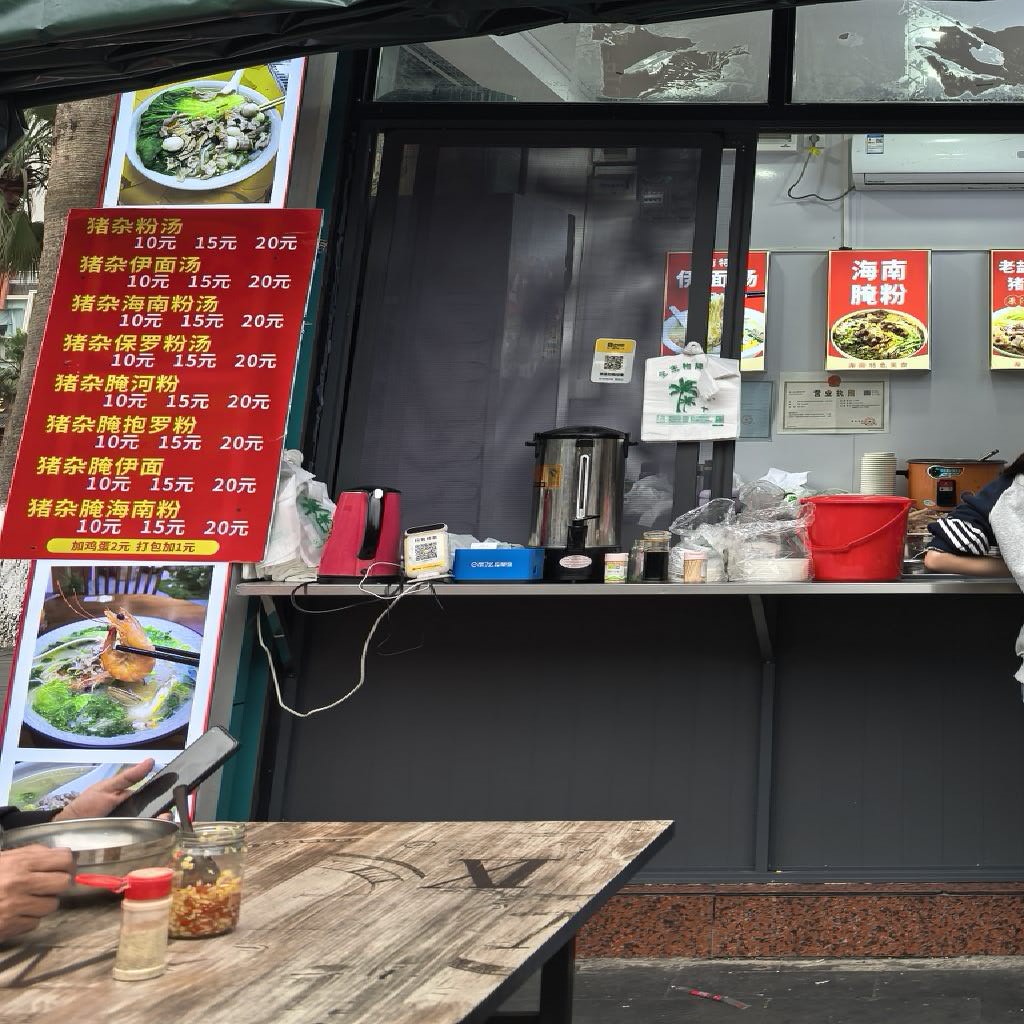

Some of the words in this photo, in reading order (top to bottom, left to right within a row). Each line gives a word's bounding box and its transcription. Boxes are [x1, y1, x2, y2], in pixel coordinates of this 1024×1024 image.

[87, 217, 183, 234] 猪杂粉汤
[135, 236, 177, 250] 10元
[195, 236, 238, 250] 15元
[255, 236, 298, 250] 20元
[80, 255, 201, 273] 猪杂伊面汤
[851, 259, 908, 282] 海南
[128, 274, 170, 289] 10元
[188, 274, 232, 289] 15元
[248, 274, 292, 289] 20元
[851, 283, 908, 306] 腌粉
[72, 294, 219, 313] 猪杂海南粉汤
[119, 313, 163, 328] 10元
[180, 313, 224, 328] 15元
[241, 313, 285, 329] 20元
[63, 334, 212, 353] 猪杂保罗粉汤
[111, 353, 156, 368] 10元
[173, 353, 217, 368] 15元
[234, 353, 277, 369] 20元
[54, 373, 179, 393] 猪杂腌河粉
[103, 393, 148, 409] 10元
[166, 393, 210, 409] 15元
[227, 394, 271, 410] 20元
[46, 414, 197, 434] 猪杂腌抱罗粉
[94, 434, 140, 450] 10元
[159, 434, 202, 450] 15元
[219, 435, 264, 451] 20元
[36, 456, 165, 476] 猪杂腌伊面
[86, 476, 132, 492] 10元
[150, 476, 194, 493] 15元
[212, 477, 257, 493] 20元
[27, 498, 181, 519] 猪杂腌海南粉
[76, 519, 122, 535] 10元
[140, 519, 186, 535] 15元
[203, 520, 249, 536] 20元
[71, 540, 131, 552] 加鸡蛋2元
[136, 541, 196, 553] 打包加1元
